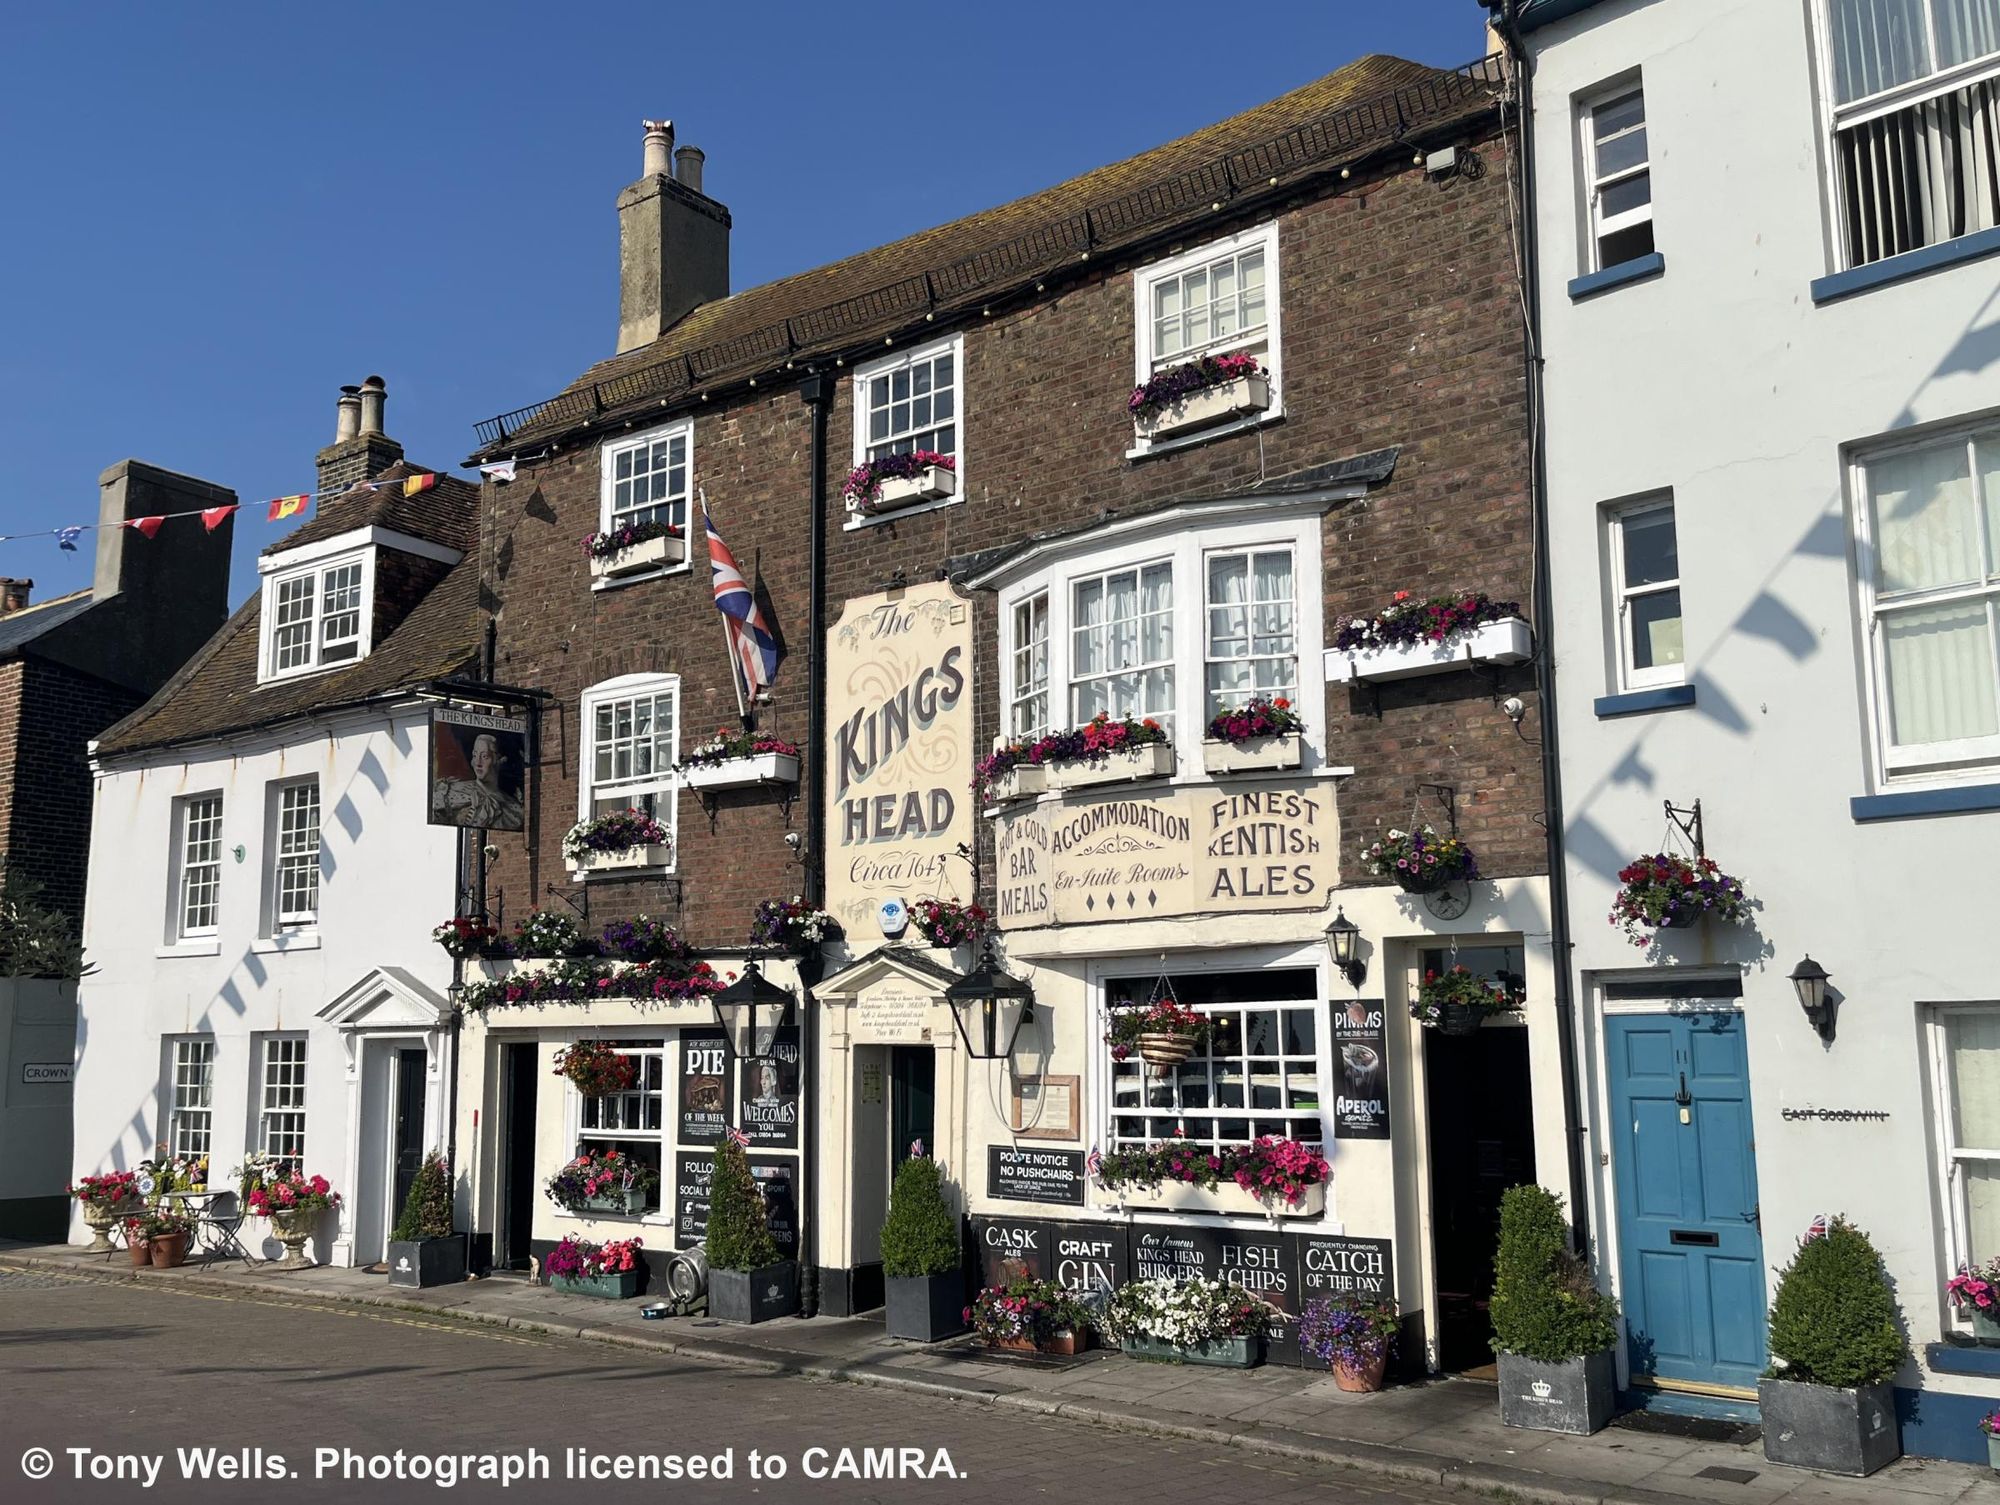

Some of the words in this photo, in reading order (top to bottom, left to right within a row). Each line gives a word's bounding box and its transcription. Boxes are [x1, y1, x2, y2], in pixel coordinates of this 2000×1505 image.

[869, 603, 915, 640] The
[440, 710, 460, 722] THE
[495, 719, 521, 731] HEAD
[836, 646, 963, 800] KINGS
[843, 788, 955, 843] HEAD
[1211, 792, 1320, 829] FINEST
[1052, 801, 1190, 854] ACCOMMODATION
[1000, 828, 1015, 861] HOT
[1016, 823, 1022, 839] &
[1024, 818, 1047, 851] COLD
[1208, 821, 1320, 857] KENTISH
[850, 855, 902, 883] Circa
[1010, 846, 1037, 878] BAR
[1128, 861, 1189, 883] Rooms
[1211, 864, 1316, 898] ALES
[1001, 882, 1048, 916] MEALS
[686, 1049, 725, 1075] PIE
[773, 1045, 798, 1064] HEAD
[26, 1069, 68, 1078] CROWN
[743, 1101, 795, 1124] WELCOMES
[1336, 1095, 1385, 1116] APEROL
[685, 1113, 693, 1121] OF
[694, 1113, 706, 1122] THE
[708, 1113, 725, 1122] WEEK
[758, 1123, 774, 1131] YOU
[685, 1161, 715, 1173] FOLLO
[1000, 1152, 1031, 1164] POLTE
[1033, 1154, 1069, 1166] NOTICE
[1000, 1165, 1014, 1177] NO
[1017, 1166, 1074, 1181] PUSHCHAIRS
[680, 1184, 704, 1196] SOCIAL
[985, 1226, 1038, 1249] CASK
[1142, 1233, 1159, 1245] Our
[1162, 1235, 1194, 1248] famous
[1309, 1241, 1345, 1249] FREQUENTLY
[1348, 1243, 1379, 1251] CHANGING
[1004, 1249, 1021, 1257] ALES
[1058, 1240, 1113, 1258] CRAFT
[1137, 1247, 1170, 1262] KINGS
[1174, 1250, 1204, 1264] HEAD
[1222, 1245, 1280, 1269] FISH
[1138, 1262, 1204, 1281] BURGERS
[1306, 1248, 1384, 1275] CATCH
[1058, 1259, 1115, 1292] GIN
[1217, 1268, 1226, 1281] &
[1228, 1268, 1287, 1292] CHIPS
[1306, 1273, 1323, 1288] OF
[1327, 1274, 1353, 1290] THE
[1356, 1276, 1385, 1292] DAY
